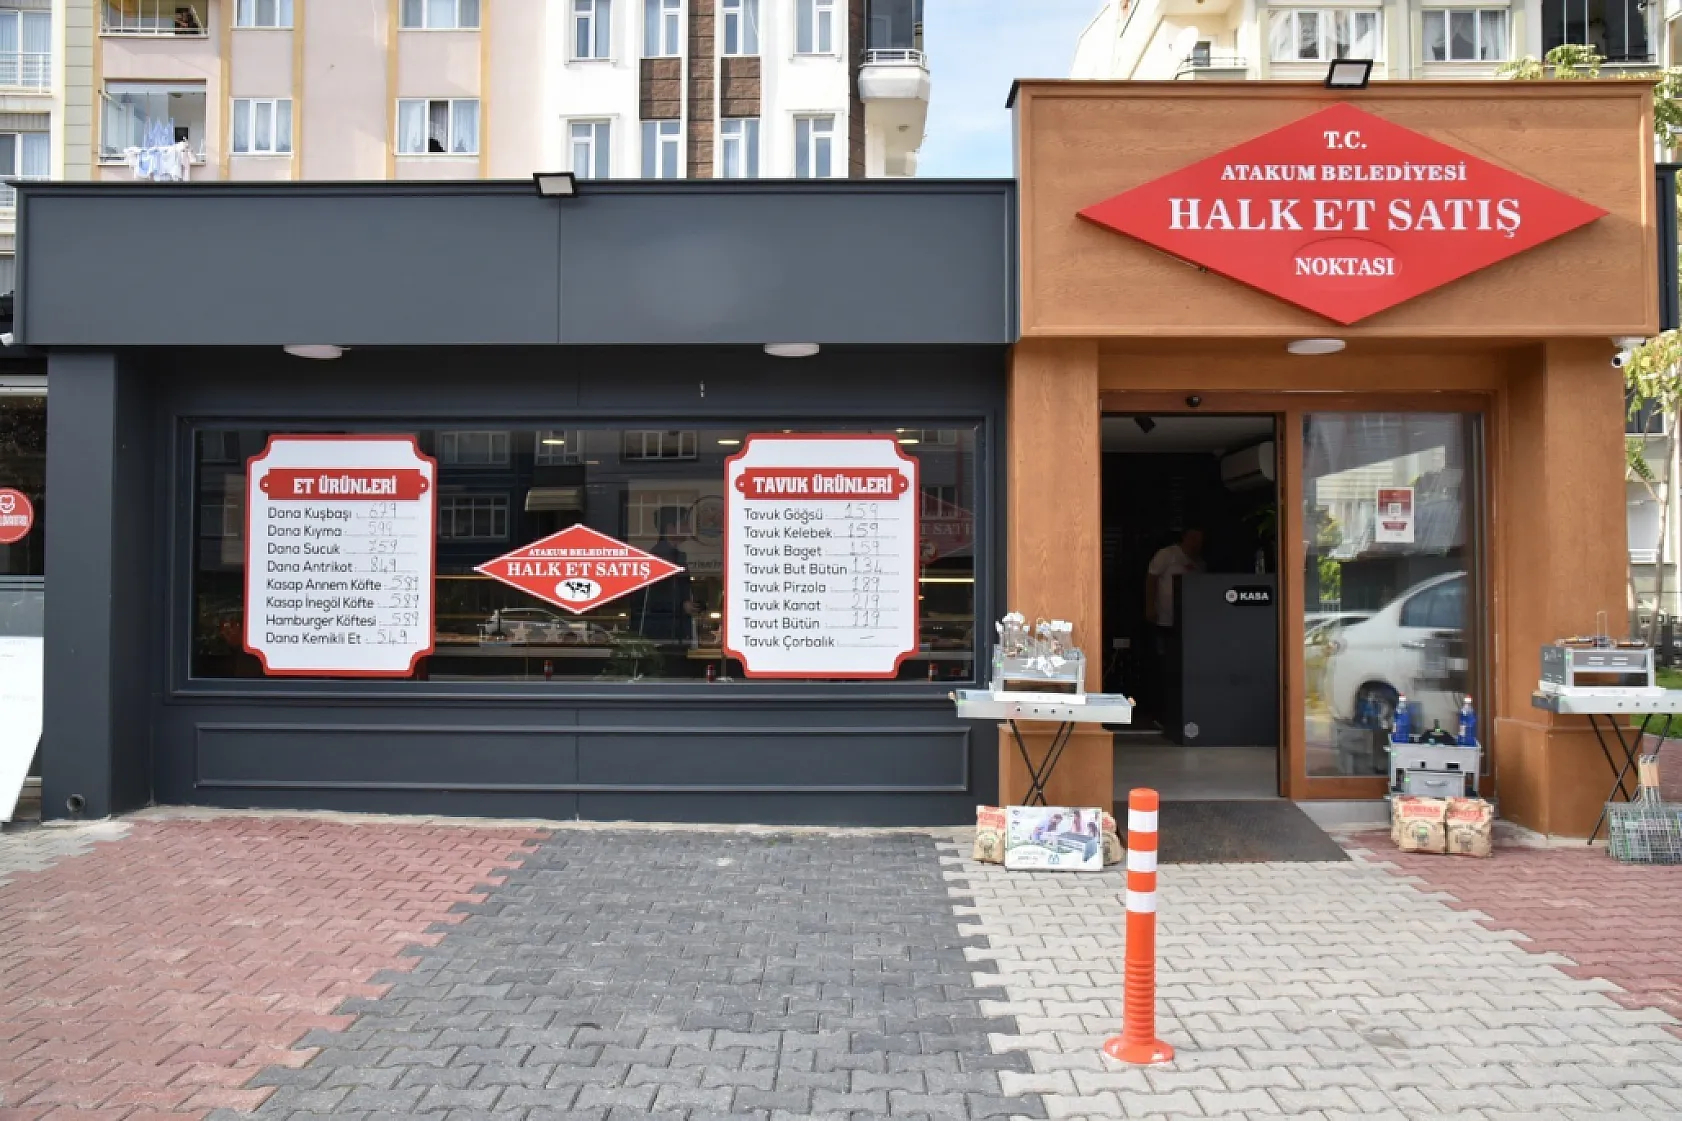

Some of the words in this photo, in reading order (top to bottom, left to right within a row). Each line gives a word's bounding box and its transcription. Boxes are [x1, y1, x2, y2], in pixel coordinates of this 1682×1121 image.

[1323, 131, 1367, 150] T.C.
[1221, 165, 1316, 181] ATAKUM
[1321, 161, 1467, 181] BELEDİYESİ
[1168, 198, 1301, 231] HALK
[1314, 199, 1376, 231] ET
[1388, 198, 1521, 237] SATIŞ
[1295, 257, 1395, 276] NOKTASI
[293, 478, 314, 494] ET
[318, 474, 397, 494] ÜRÜNLERİ
[753, 476, 809, 493] TAVUK
[812, 473, 893, 493] ÜRÜNLERİ
[267, 507, 302, 519] Dana
[304, 507, 352, 521] Kuşbaşı
[744, 507, 781, 520] Tavuk
[784, 507, 823, 524] Göğsü
[267, 525, 302, 537] Dana
[304, 525, 343, 539] Kıyma
[744, 525, 781, 538] Tavuk
[784, 525, 833, 539] Kelebek
[267, 543, 302, 555] Dana
[303, 542, 341, 555] Sucuk
[528, 548, 568, 556] ATAKUM
[569, 546, 629, 556] BELEDİYESİ
[744, 543, 781, 556] Tavuk
[784, 544, 822, 560] Baget
[267, 561, 302, 573] Dana
[303, 560, 354, 573] Antrikot
[506, 562, 562, 576] HALK
[565, 562, 592, 576] ET
[595, 562, 651, 580] SATIŞ
[744, 562, 781, 575] Tavuk
[784, 563, 805, 575] But
[809, 562, 848, 575] Bütün
[266, 579, 303, 593] Kasap
[305, 578, 349, 590] Annem
[350, 578, 382, 590] Köfte
[744, 581, 781, 593] Tavuk
[783, 581, 827, 593] Pirzola
[265, 596, 303, 611] Kasap
[304, 593, 341, 612] İnegöl
[342, 596, 375, 608] Köfte
[1240, 592, 1269, 601] KASA
[744, 599, 781, 611] Tavuk
[783, 599, 821, 611] Kanat
[265, 614, 335, 629] Hamburger
[336, 614, 377, 626] Köftesi
[744, 617, 779, 629] Tavut
[782, 617, 820, 629] Bütün
[265, 632, 300, 644] Dana
[302, 632, 346, 644] Kemikli
[347, 632, 362, 644] Et
[743, 635, 781, 648] Tavuk
[782, 635, 836, 651] Çorbalık
